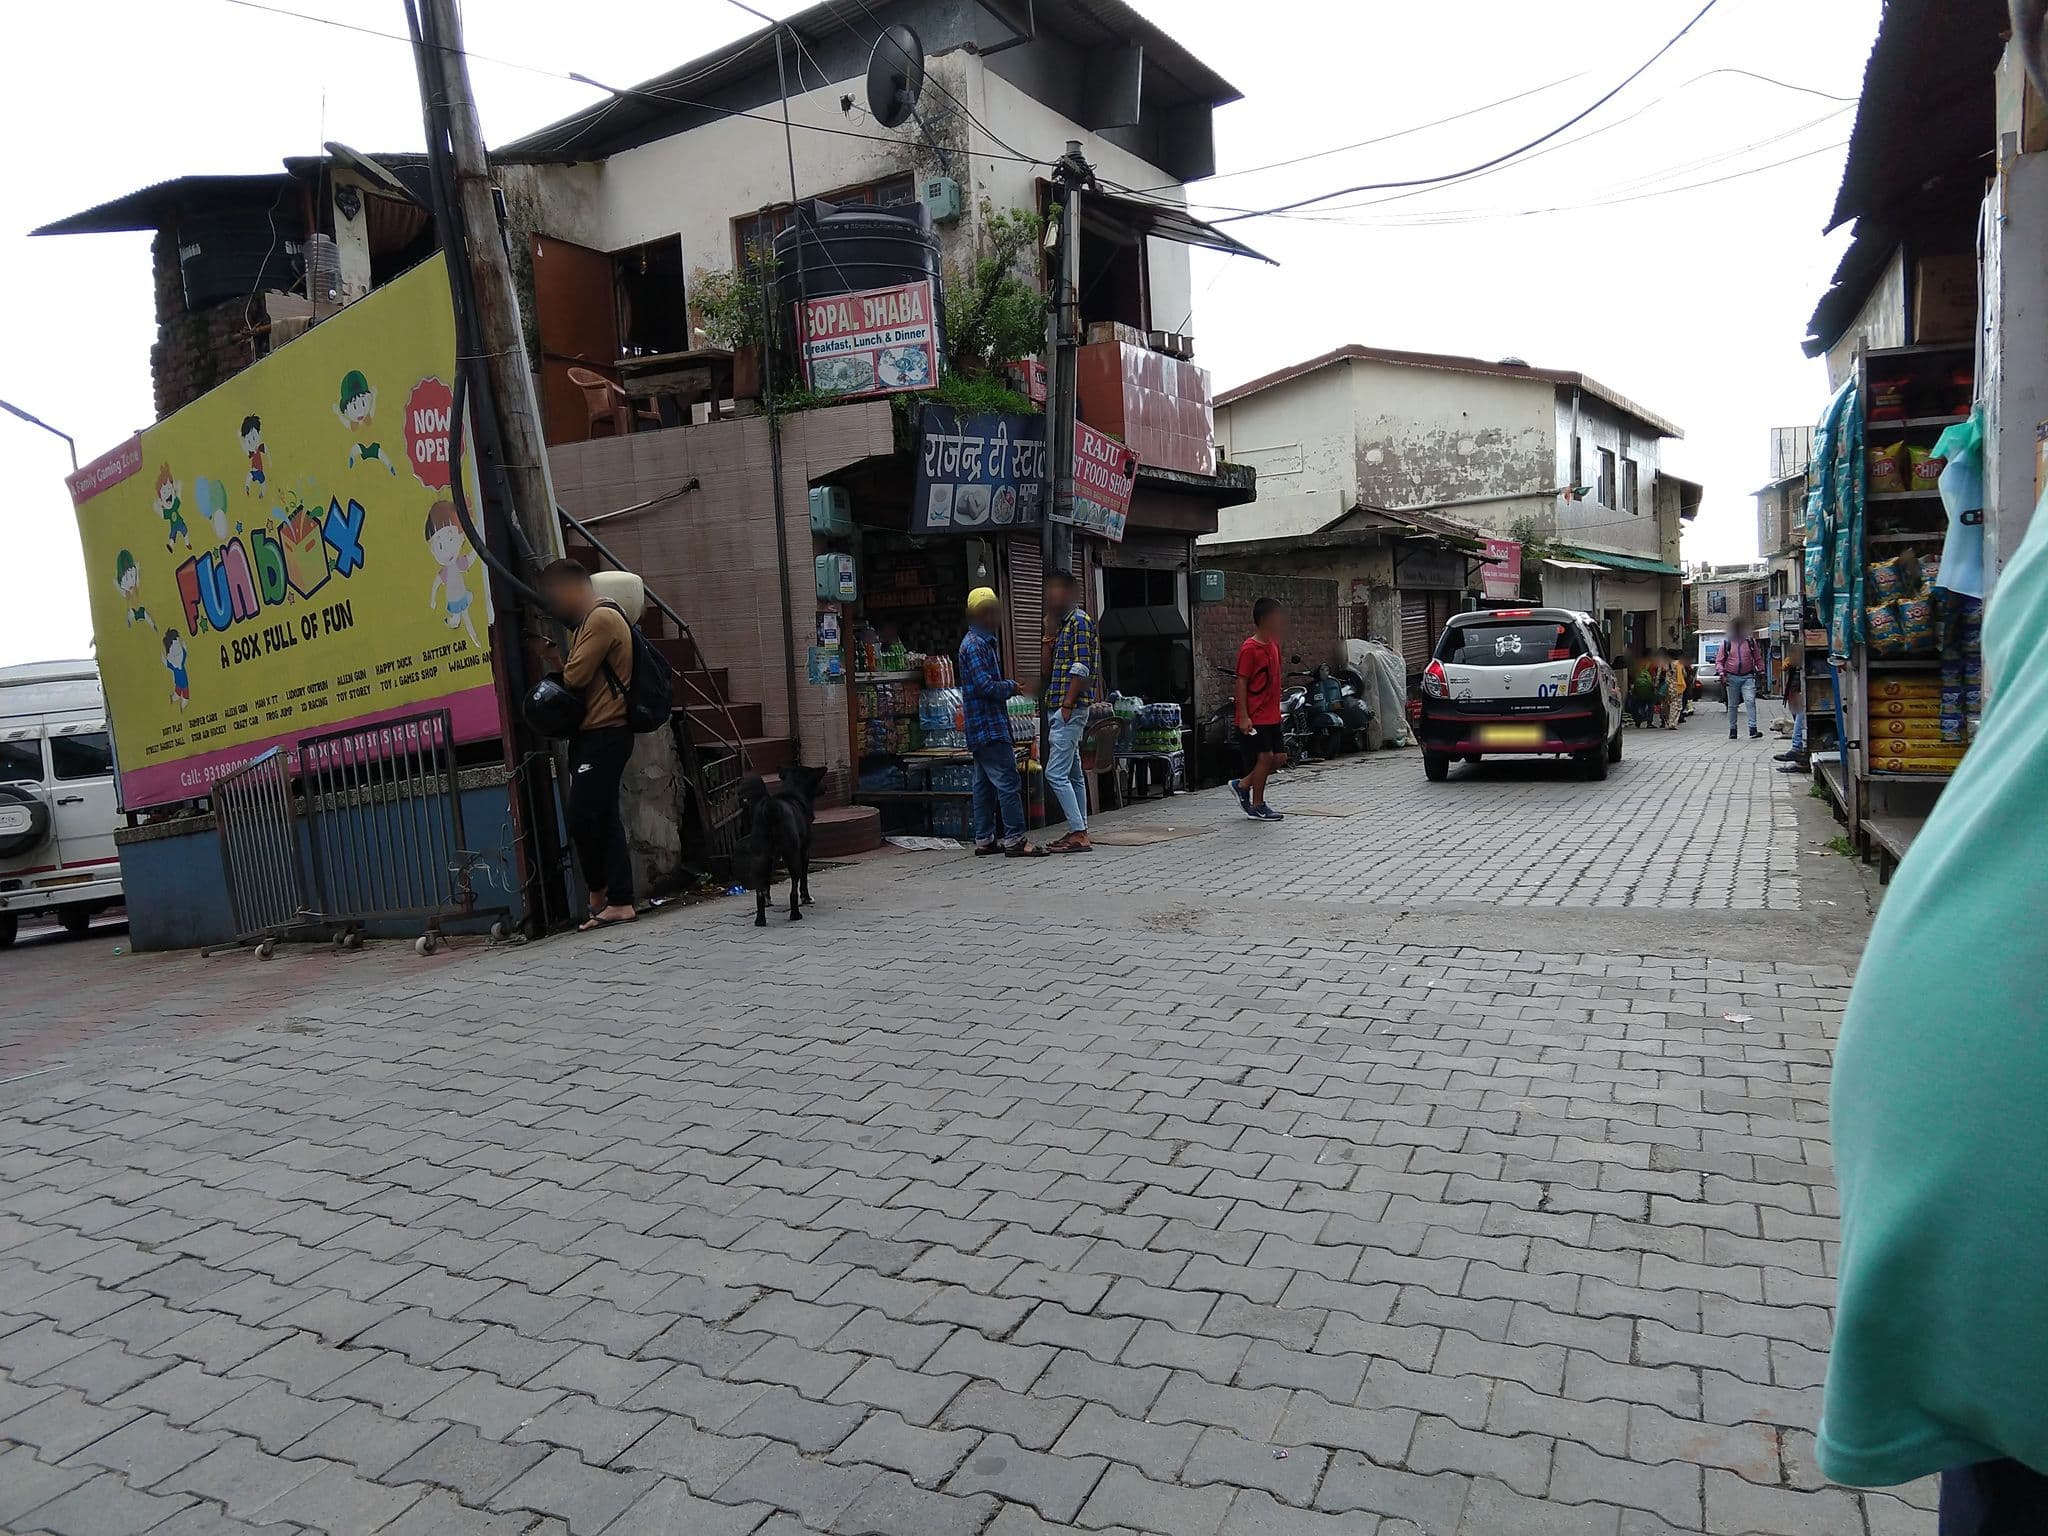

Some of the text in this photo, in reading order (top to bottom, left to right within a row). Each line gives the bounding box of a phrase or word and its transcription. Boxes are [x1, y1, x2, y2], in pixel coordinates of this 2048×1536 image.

[803, 291, 923, 338] GOPAL DHABA
[854, 333, 882, 347] Lunch
[885, 332, 892, 342] &
[895, 329, 926, 341] Dinner
[414, 407, 451, 434] NOW
[989, 421, 1009, 479] टी
[1082, 432, 1120, 467] RAJU
[97, 461, 122, 481] Gaming
[1083, 460, 1108, 488] FOOD
[1109, 473, 1132, 498] SHOP
[1872, 463, 1894, 476] HIPS
[221, 599, 354, 669] A BOX FULL OF FUN
[337, 673, 354, 686] ALIEN
[354, 669, 367, 682] GUN
[375, 661, 395, 675] HAPPY
[396, 656, 413, 669] DUCK
[422, 645, 452, 662] BATTERY
[453, 640, 467, 653] CAR
[308, 696, 328, 709] RACING
[336, 691, 349, 703] TOY
[350, 685, 371, 699] STOREY
[380, 679, 392, 691] TOY
[399, 671, 420, 686] GAMES
[421, 666, 438, 679] SHOP
[448, 654, 480, 672] WALKING
[180, 770, 202, 787] Call:
